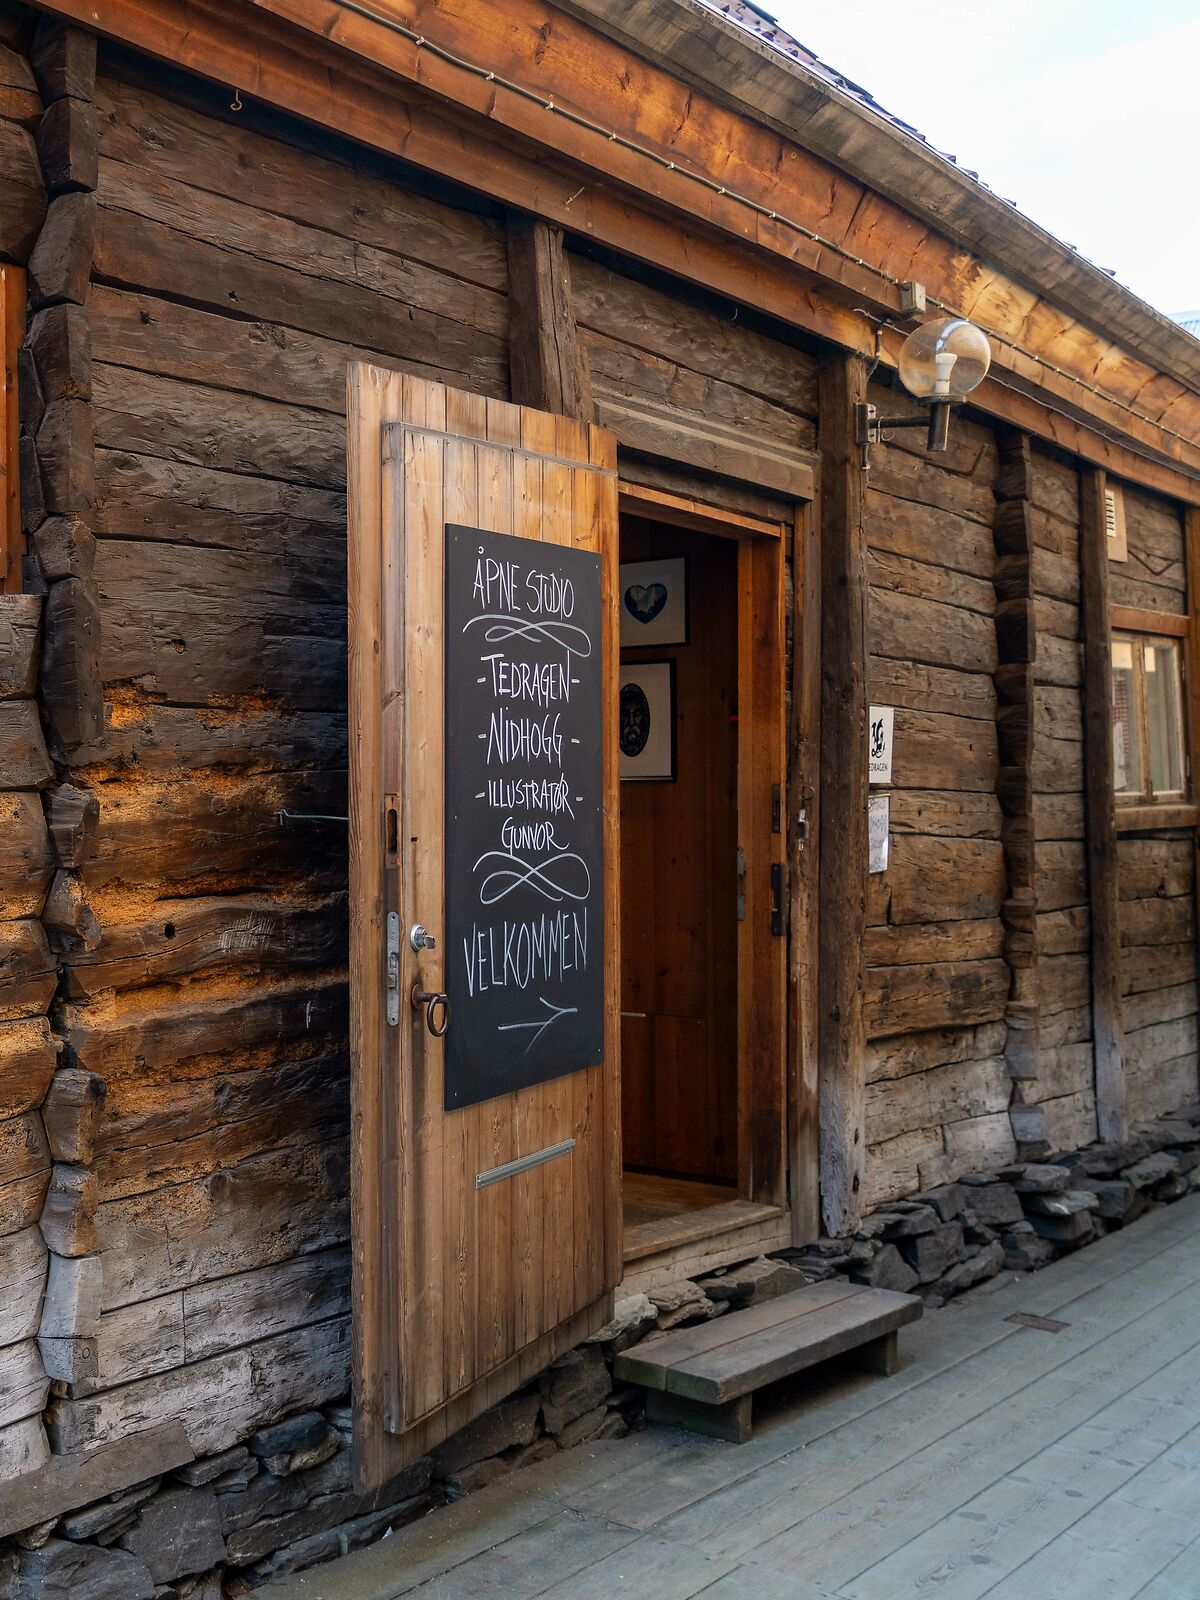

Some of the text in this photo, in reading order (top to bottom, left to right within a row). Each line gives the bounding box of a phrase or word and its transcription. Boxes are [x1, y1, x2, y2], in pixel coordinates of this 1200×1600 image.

[473, 545, 575, 621] ÅPNE STUDIO
[501, 816, 569, 851] GUNVOR
[464, 906, 587, 997] VELKOMMEN
